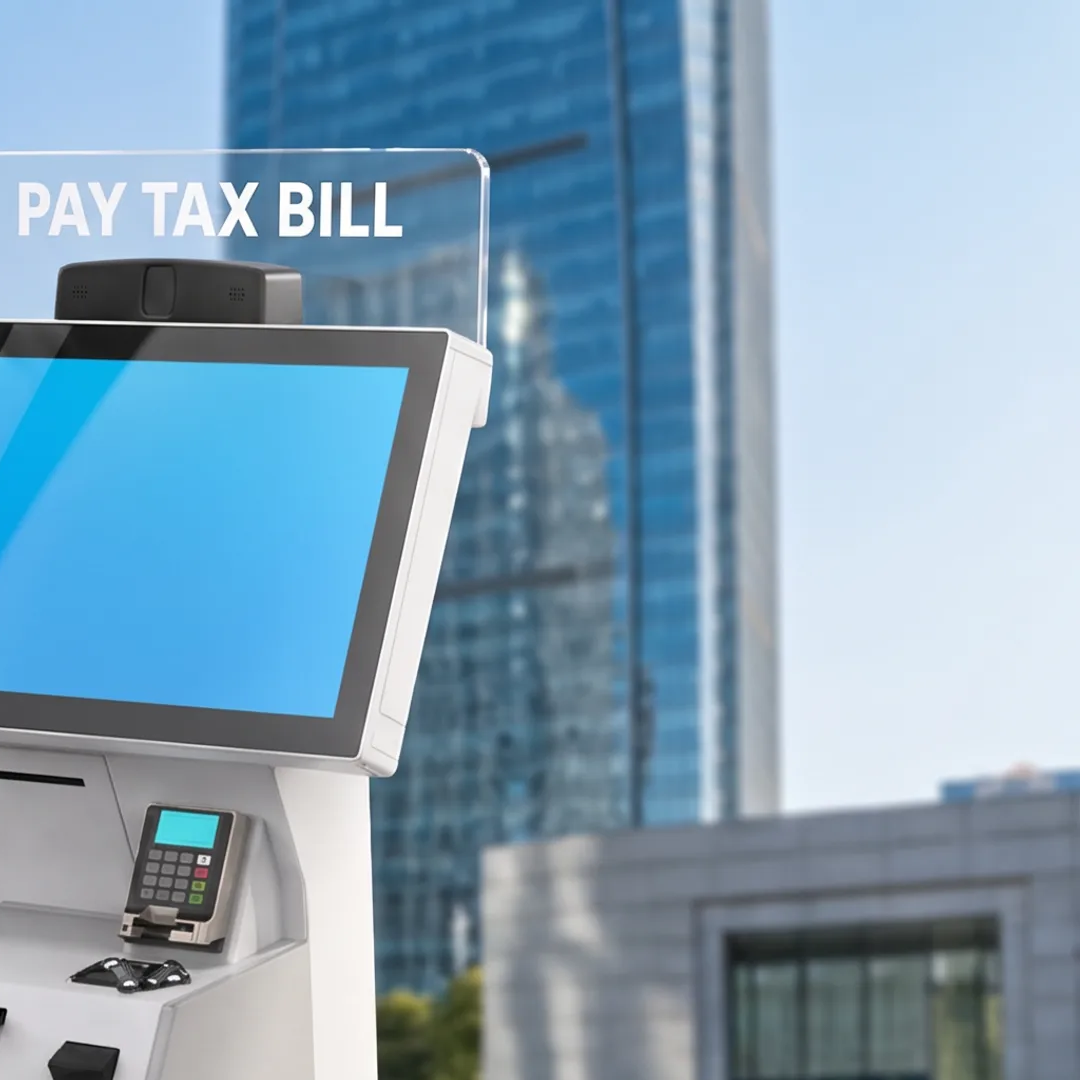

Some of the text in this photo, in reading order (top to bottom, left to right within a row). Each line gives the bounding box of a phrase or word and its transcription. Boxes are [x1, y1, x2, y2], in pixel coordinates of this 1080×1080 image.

[18, 182, 403, 237] PAY TAX BILL
